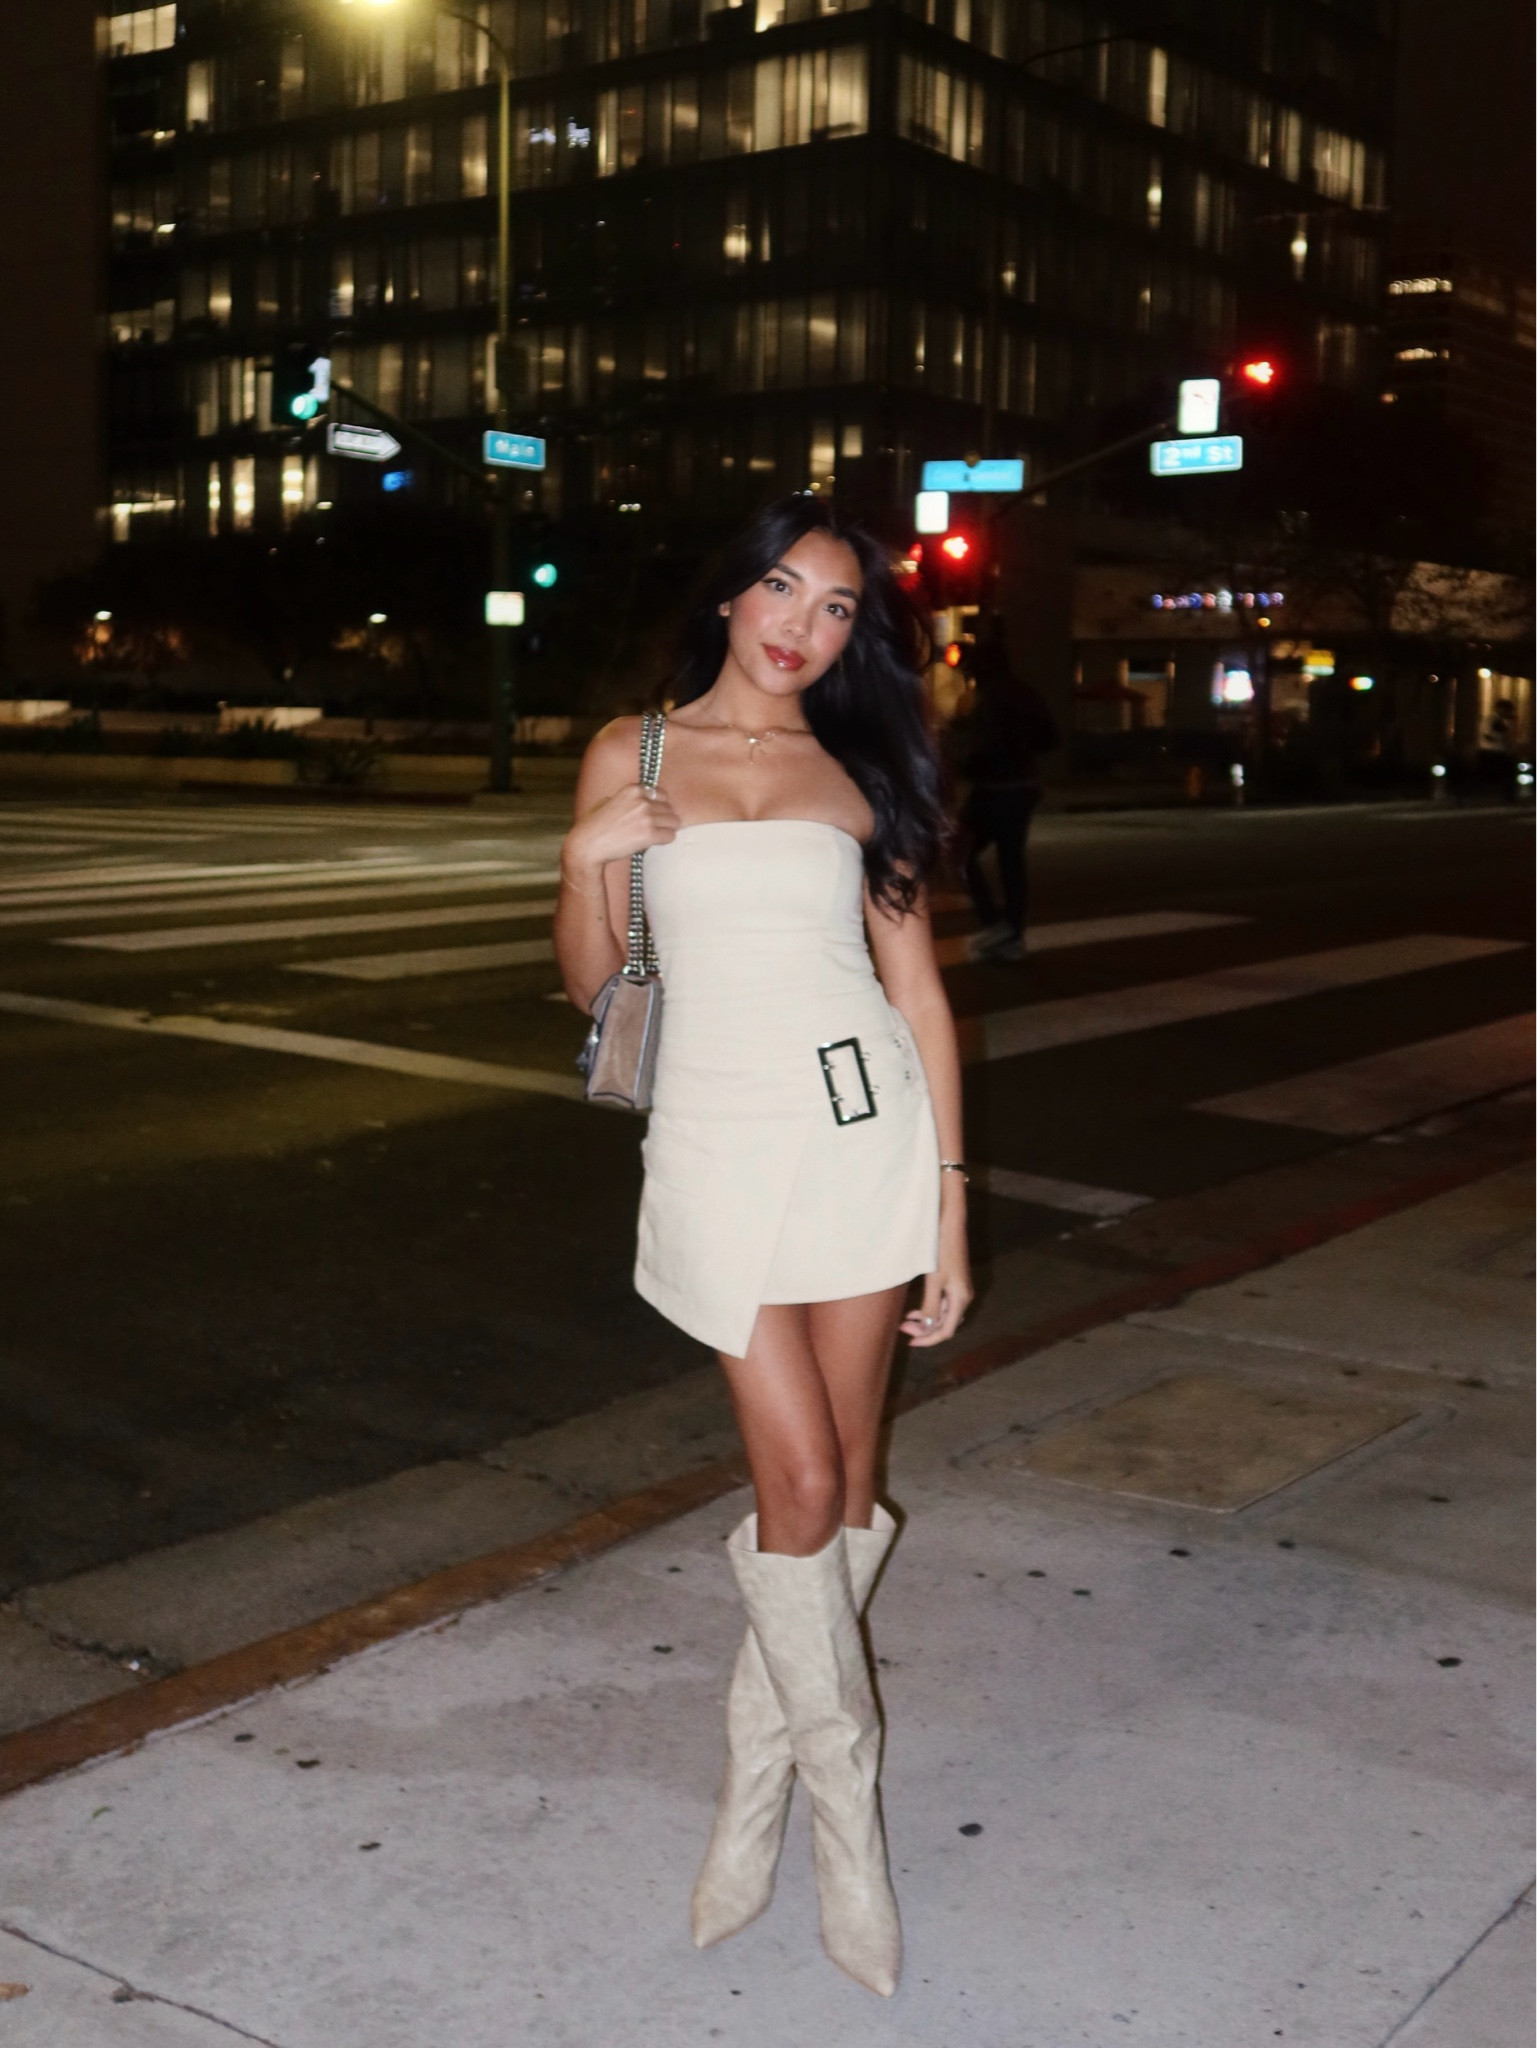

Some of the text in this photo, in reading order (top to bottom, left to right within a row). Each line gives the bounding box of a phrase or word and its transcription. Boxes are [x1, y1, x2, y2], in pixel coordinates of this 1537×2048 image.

[495, 439, 536, 459] Main
[1162, 444, 1232, 467] 2nd St
